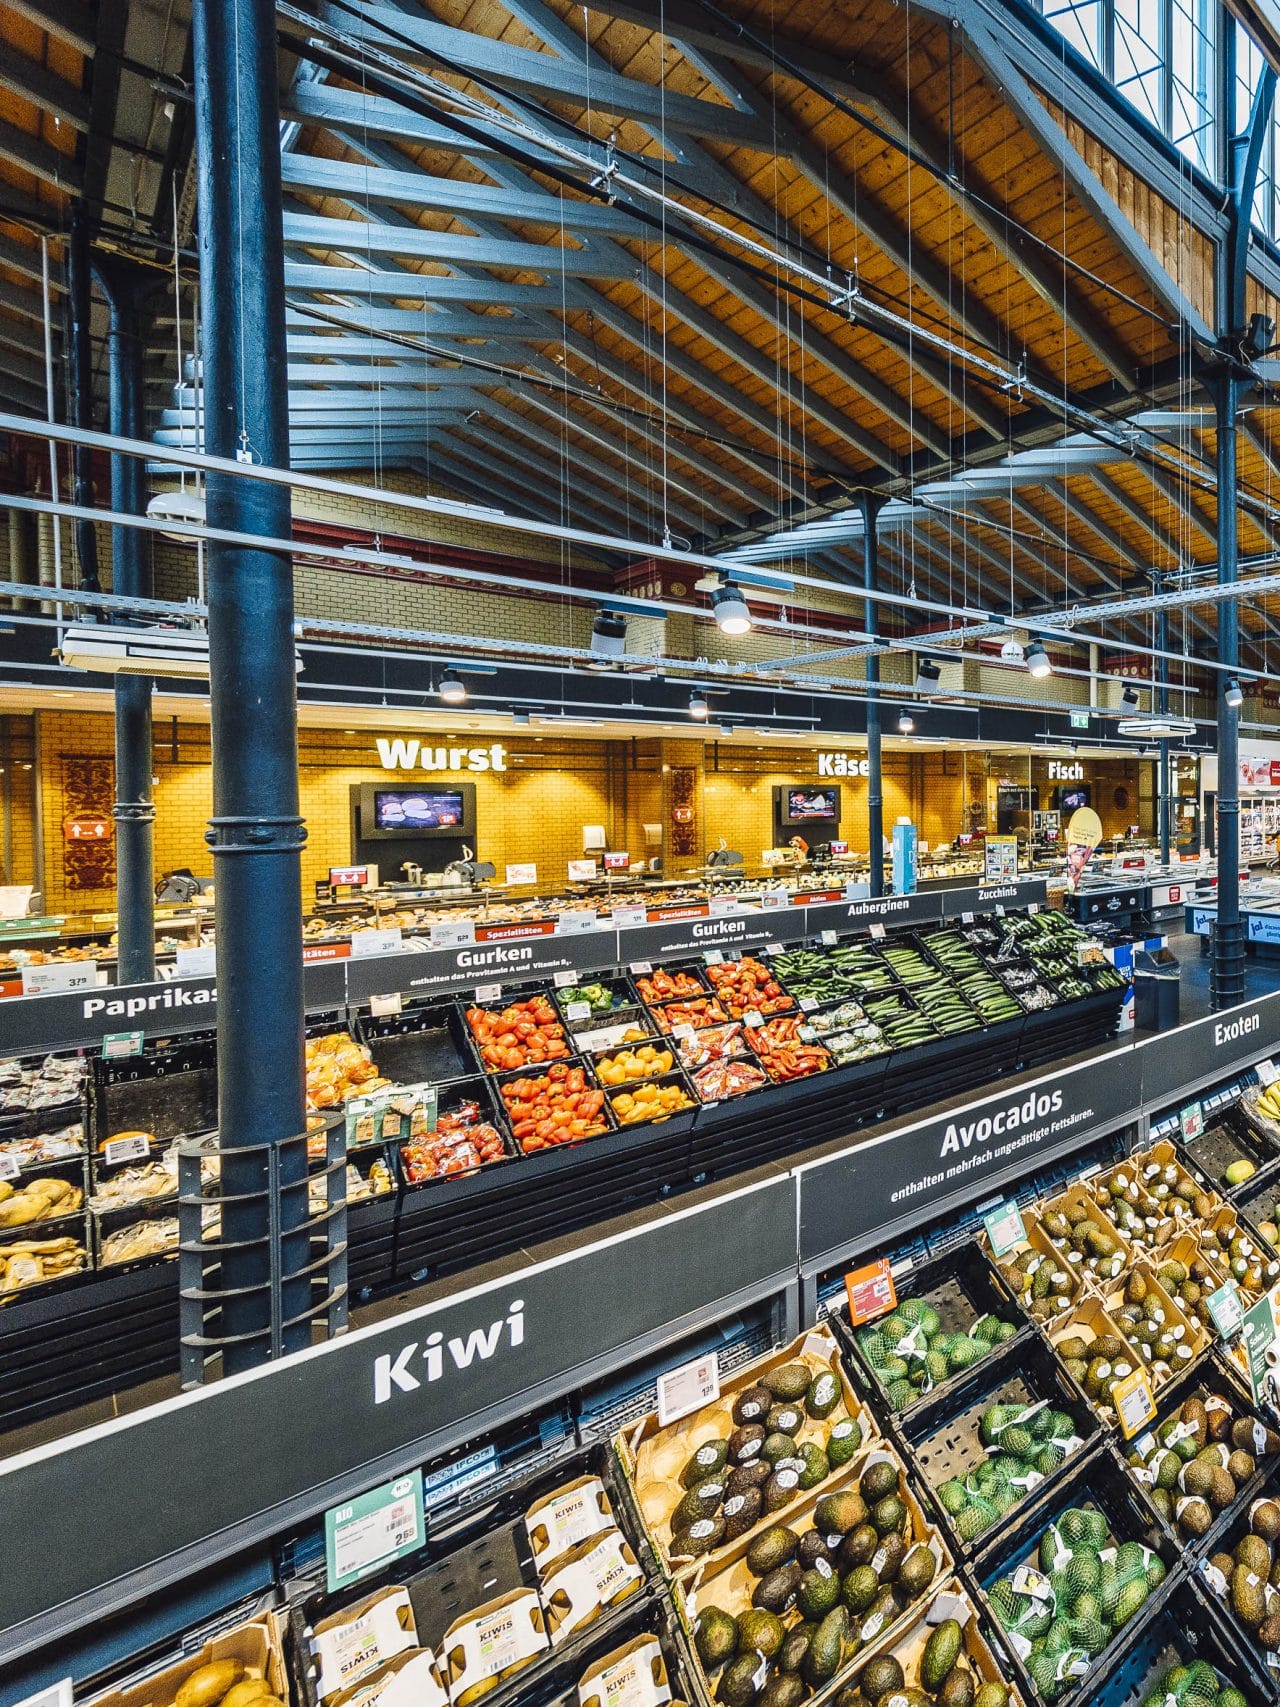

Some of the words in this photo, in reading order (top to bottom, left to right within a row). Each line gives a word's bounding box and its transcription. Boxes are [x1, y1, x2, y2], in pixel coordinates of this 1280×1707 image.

[376, 738, 507, 771] Wurst
[818, 754, 869, 777] Käse
[1048, 761, 1084, 780] Fisch
[978, 886, 1018, 900] Zucchinis
[659, 909, 702, 920] Spezialitäten
[848, 900, 910, 916] Auberginen
[487, 927, 543, 939] Spezialitäten
[692, 920, 746, 937] Gurken
[456, 946, 533, 967] Gurken
[410, 974, 450, 986] enthalten
[451, 972, 465, 981] das
[467, 967, 508, 979] Provitamin
[516, 963, 531, 971] und
[533, 959, 561, 969] Vitamin
[84, 986, 217, 1019] Paprikas
[1214, 1012, 1260, 1046] Exoten
[939, 1089, 1063, 1158] Avocados
[891, 1171, 945, 1203] enthalten
[946, 1150, 993, 1179] mehrfach
[994, 1127, 1050, 1159] ungesättigte
[1050, 1108, 1095, 1134] Fettsäuren.
[374, 1299, 525, 1404] Kiwi
[456, 1454, 480, 1470] IFCO
[456, 1471, 481, 1486] IFCO
[335, 1506, 353, 1524] BIO
[554, 1500, 584, 1520] KIWIS
[596, 1565, 625, 1591] KIWIS
[479, 1620, 513, 1643] KIWIS
[340, 1645, 379, 1674] KIWIS
[606, 1670, 636, 1693] KIWIS
